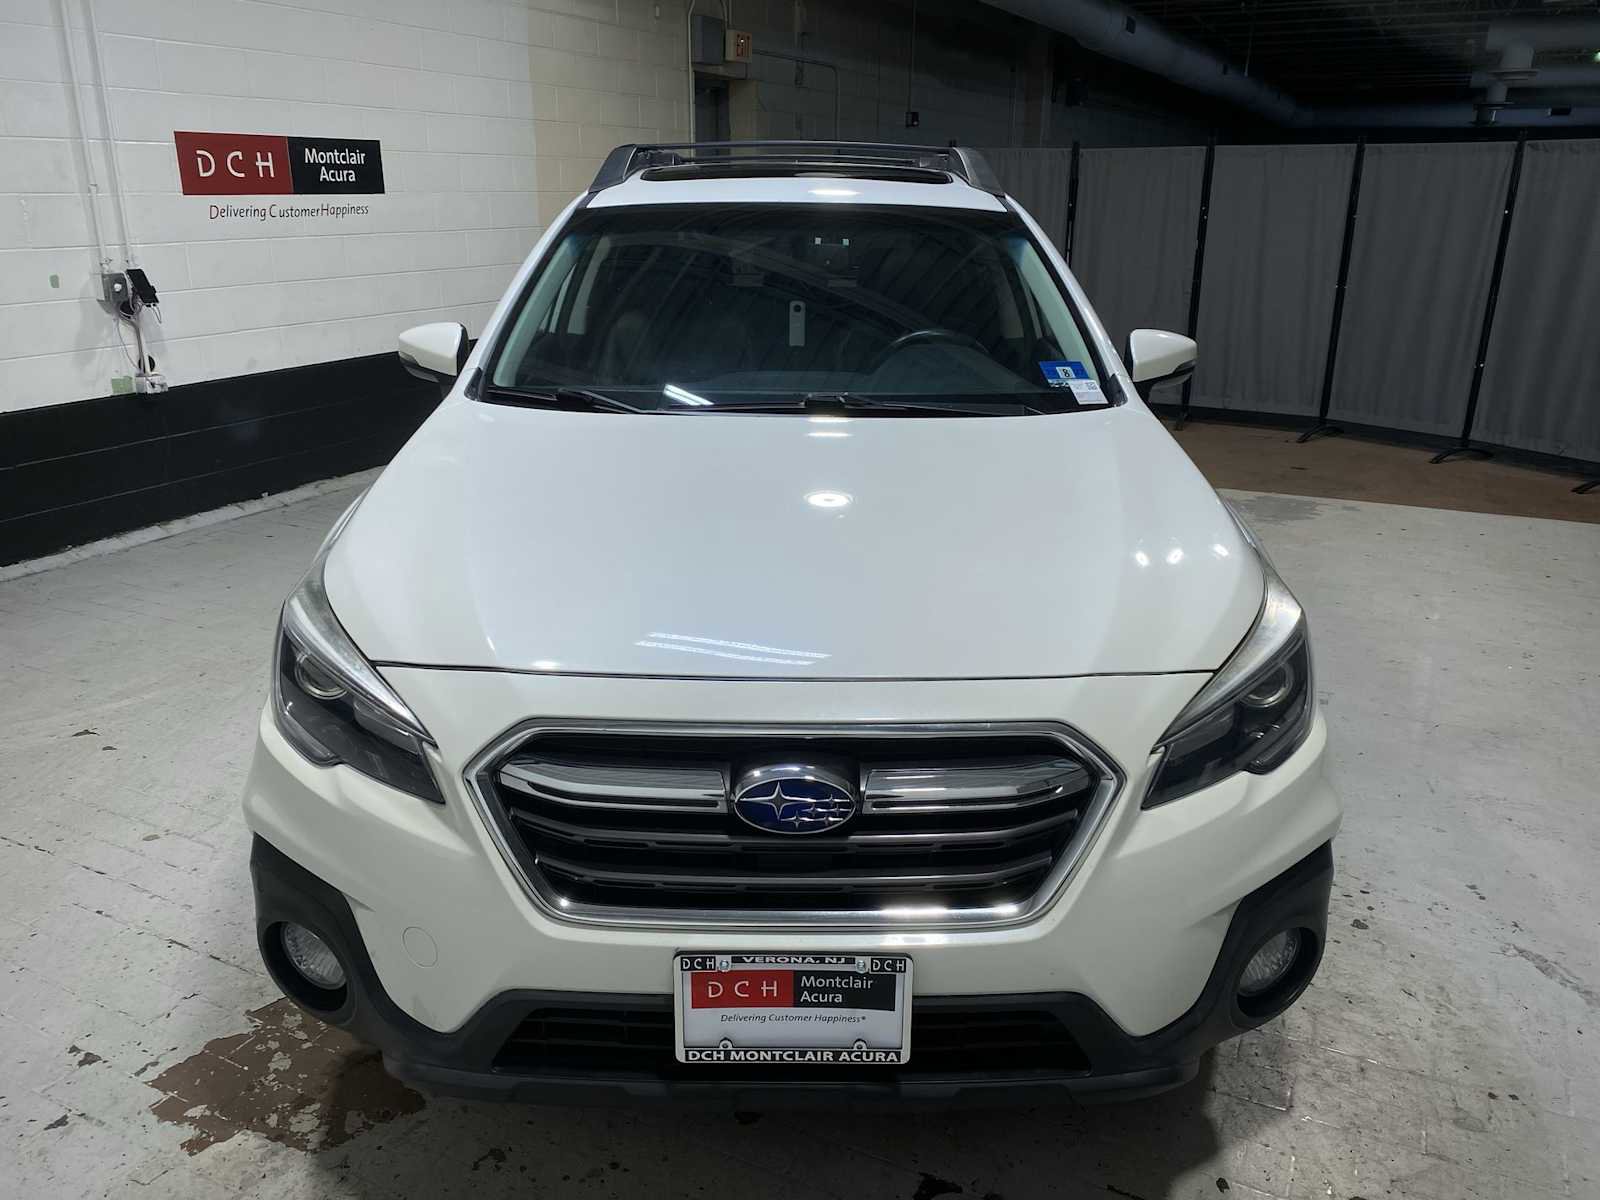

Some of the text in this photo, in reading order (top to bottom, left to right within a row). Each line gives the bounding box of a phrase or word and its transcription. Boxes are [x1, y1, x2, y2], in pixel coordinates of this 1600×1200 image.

[304, 148, 366, 165] Montclair
[319, 166, 356, 182] Acura
[209, 204, 267, 221] Delivering
[1062, 368, 1070, 378] 8
[682, 958, 716, 970] DCH
[872, 959, 906, 971] DCH
[800, 976, 874, 989] Montclair
[707, 980, 778, 998] DCH
[800, 991, 843, 1003] Acura
[720, 1014, 767, 1023] Delivering
[768, 1014, 813, 1022] Customer
[687, 1050, 899, 1062] DCH MONTCLAIR ACURA
